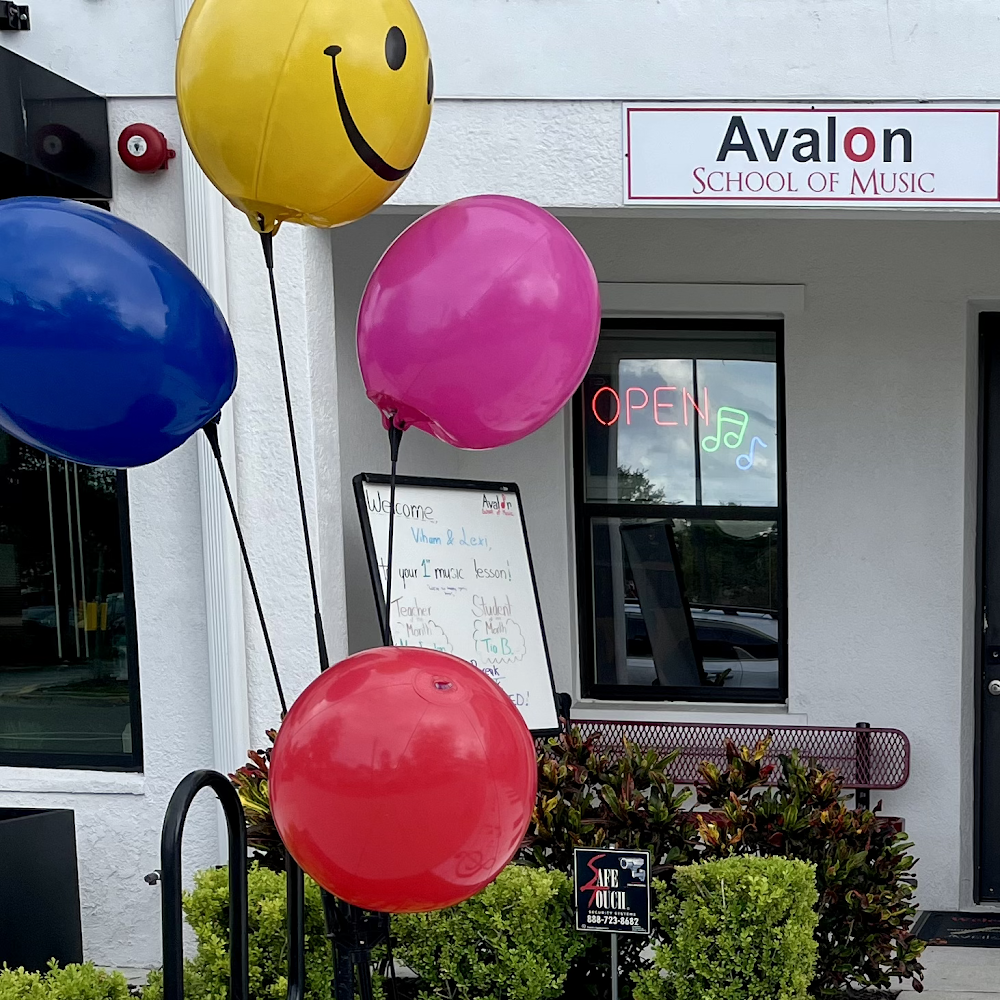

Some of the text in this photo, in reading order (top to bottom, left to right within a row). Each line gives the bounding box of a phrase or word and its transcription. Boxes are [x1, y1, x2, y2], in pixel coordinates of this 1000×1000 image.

[716, 115, 913, 163] Avalon
[692, 167, 935, 195] SCHOOL OF MUSIC
[592, 386, 710, 426] OPEN
[447, 529, 454, 545] &
[399, 568, 417, 589] your
[434, 567, 464, 579] music
[473, 559, 512, 581] lesson!
[391, 596, 431, 617] Teacher
[471, 594, 512, 617] Student
[406, 623, 432, 637] Month
[485, 620, 507, 635] Month
[580, 853, 618, 891] SAFE
[587, 915, 639, 926] 888-723-8682
